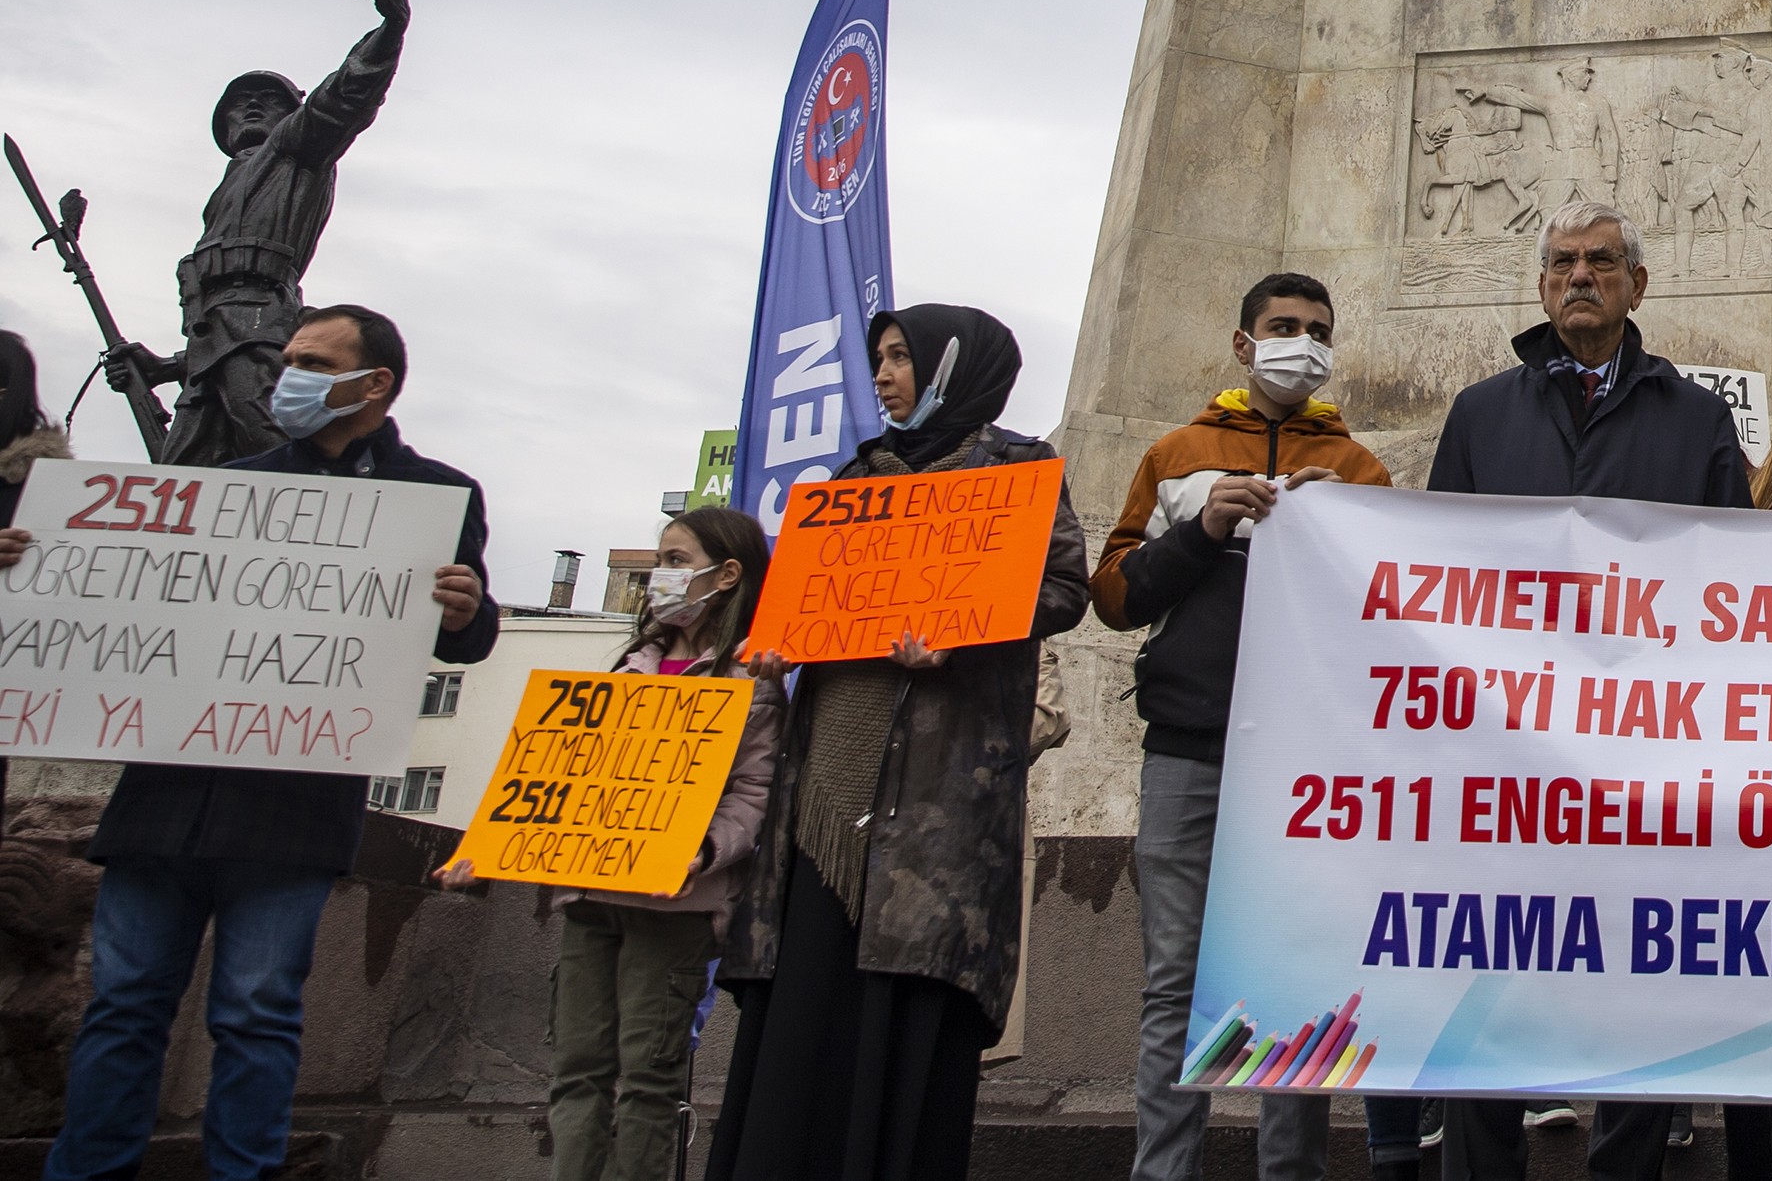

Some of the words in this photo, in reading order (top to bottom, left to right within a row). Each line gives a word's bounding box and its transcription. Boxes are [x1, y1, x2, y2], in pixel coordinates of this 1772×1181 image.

[793, 129, 805, 167] TÜM
[1687, 373, 1752, 411] 761
[66, 474, 203, 535] 2511
[211, 483, 383, 549] ENGELLİ
[798, 484, 895, 529] 2511
[904, 470, 1039, 518] ENGELLİ
[819, 514, 1011, 567] ÖĞRETMENE
[4, 539, 228, 603] ÖĞRETMEN
[233, 557, 414, 621] GÖREVİNİ
[799, 561, 981, 614] ENGELSİZ
[1361, 560, 1677, 648] AZMETTİK,
[217, 629, 366, 689] HAZIR
[780, 604, 994, 657] KONTENJAN
[97, 693, 145, 748] YA
[180, 702, 374, 762] ATAMA?
[538, 679, 614, 729] 750
[616, 682, 735, 734] YETMEZ
[1576, 679, 1704, 742] HAK
[667, 738, 713, 785] DE
[488, 778, 573, 825] 2511
[572, 784, 682, 833] ENGELLİ
[1285, 773, 1433, 841] 2511
[1460, 768, 1713, 848] ENGELLİ
[500, 827, 647, 877] ÖĞRETMEN
[1362, 891, 1605, 973] ATAMA
